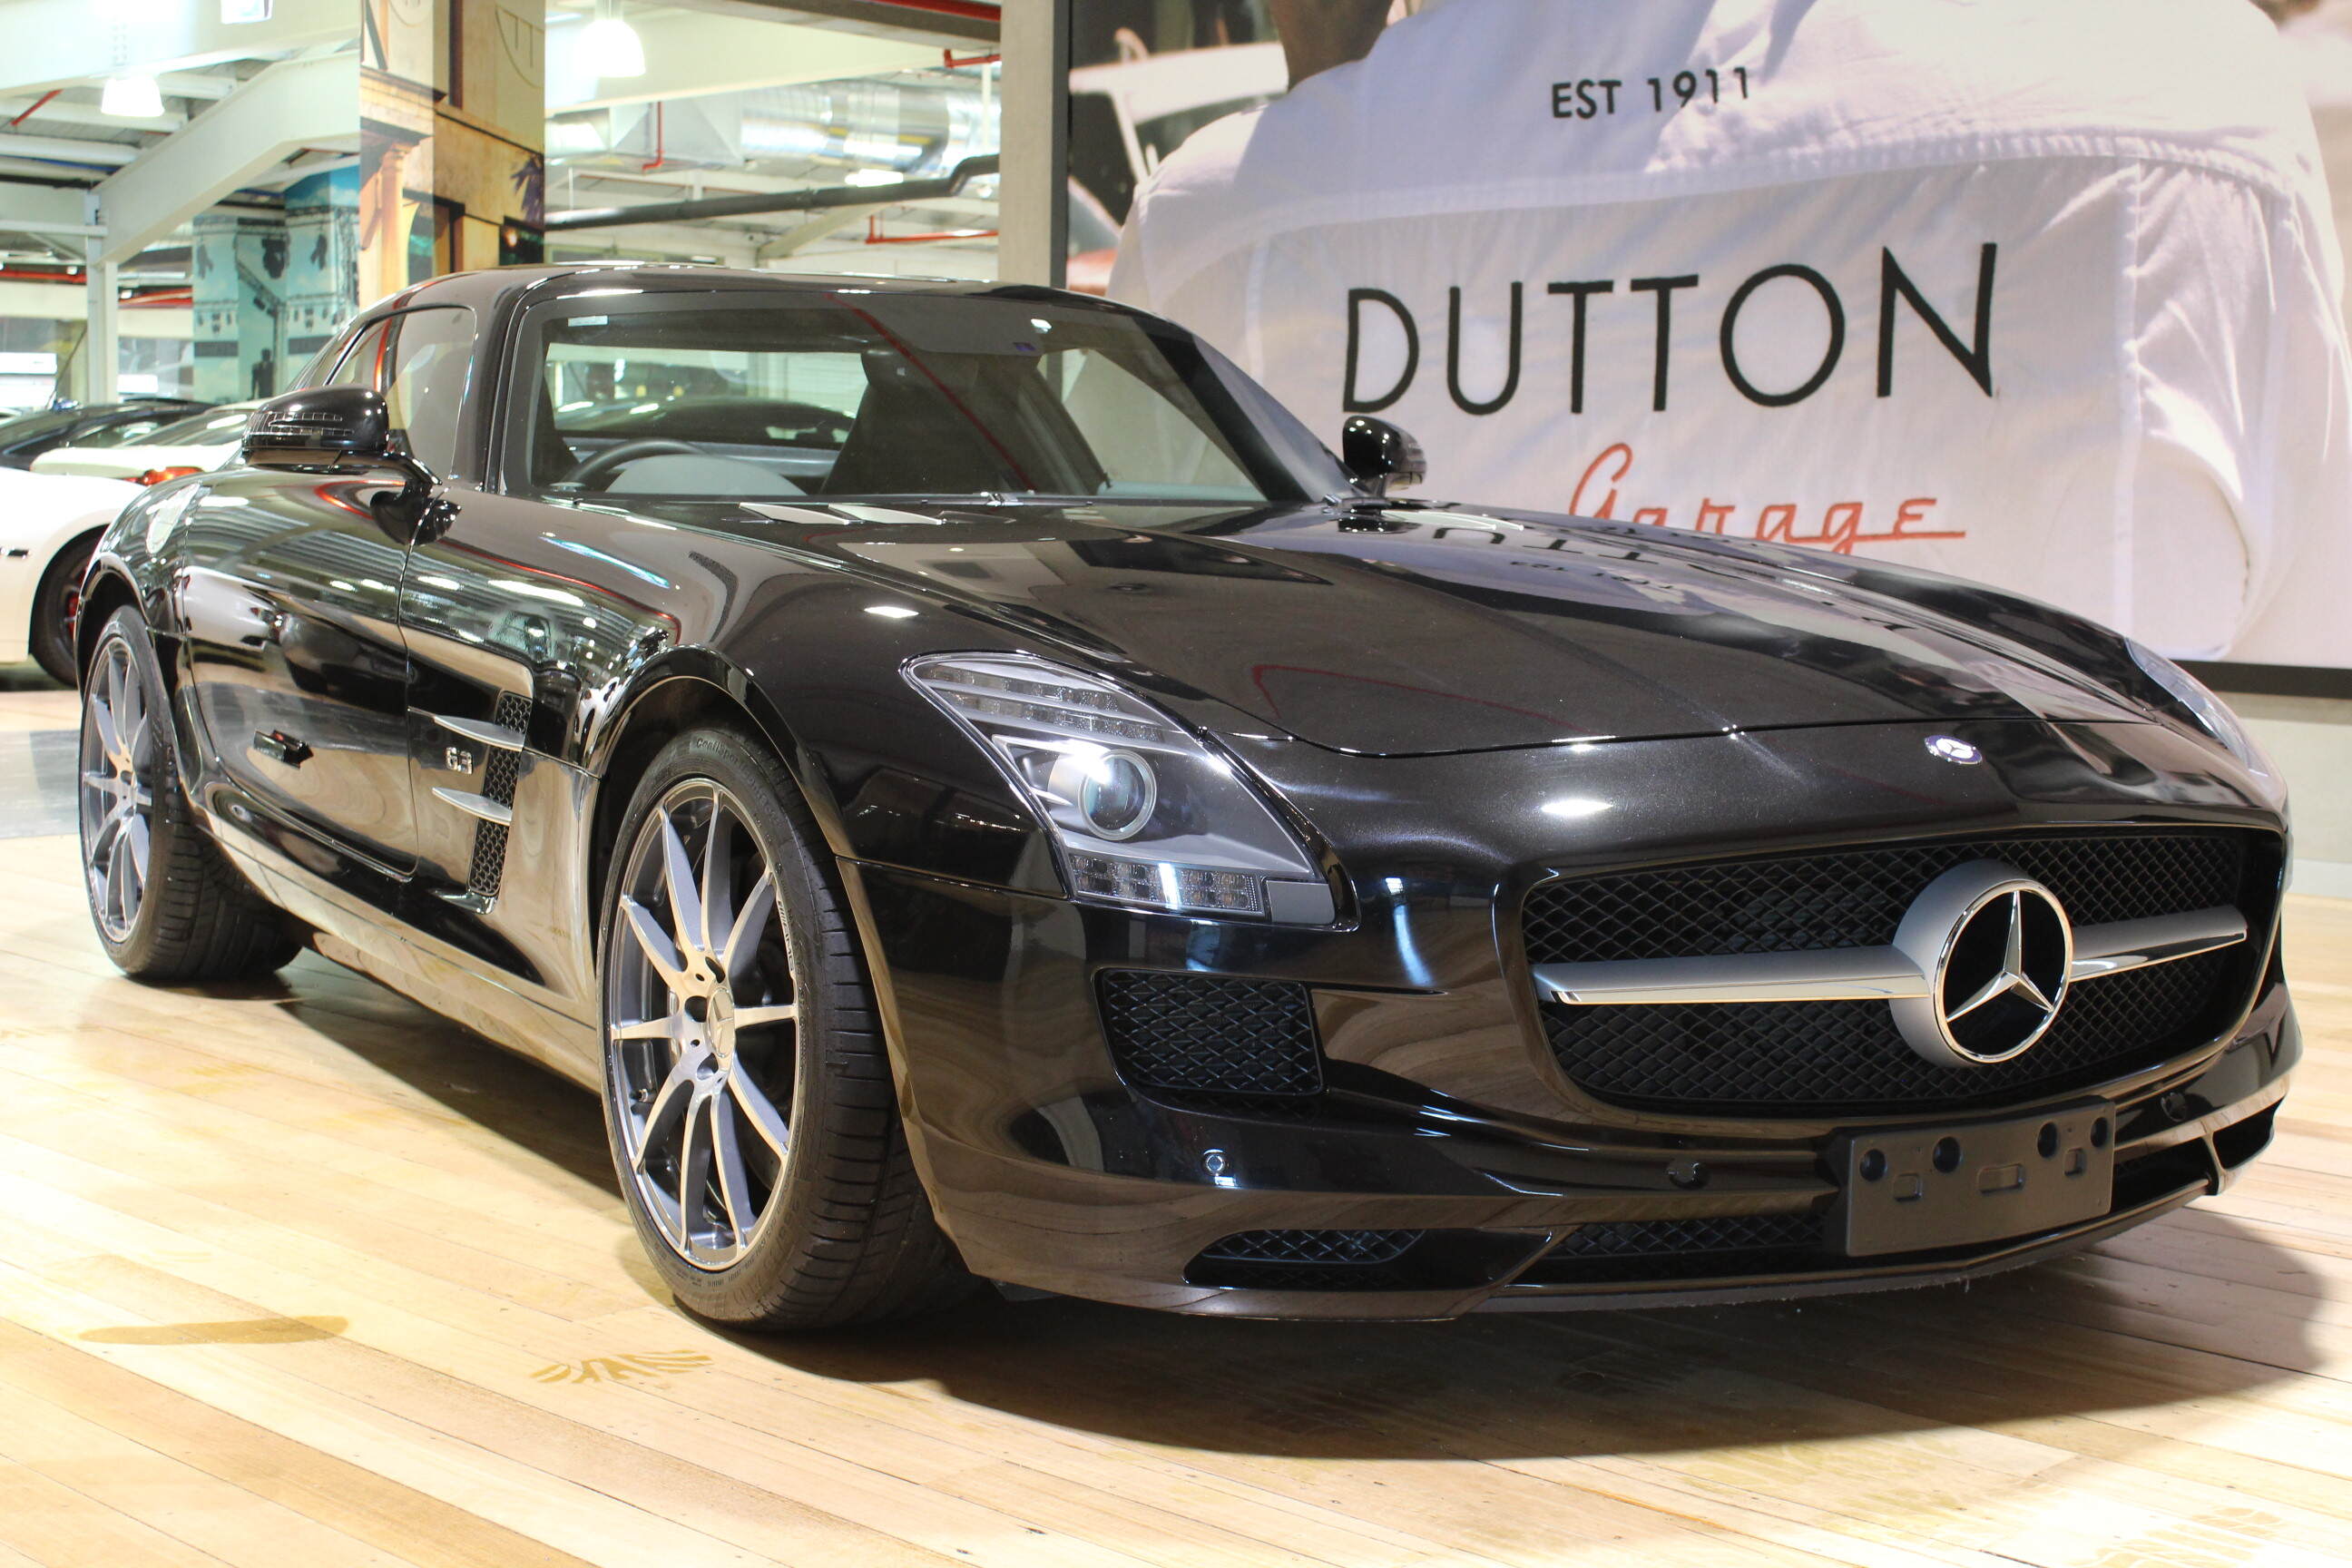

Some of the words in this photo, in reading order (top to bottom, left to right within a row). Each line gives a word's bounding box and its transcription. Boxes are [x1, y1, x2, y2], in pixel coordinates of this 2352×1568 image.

[1552, 79, 1622, 120] EST
[1647, 66, 1749, 113] 1911
[1342, 240, 1998, 416] DUTTON
